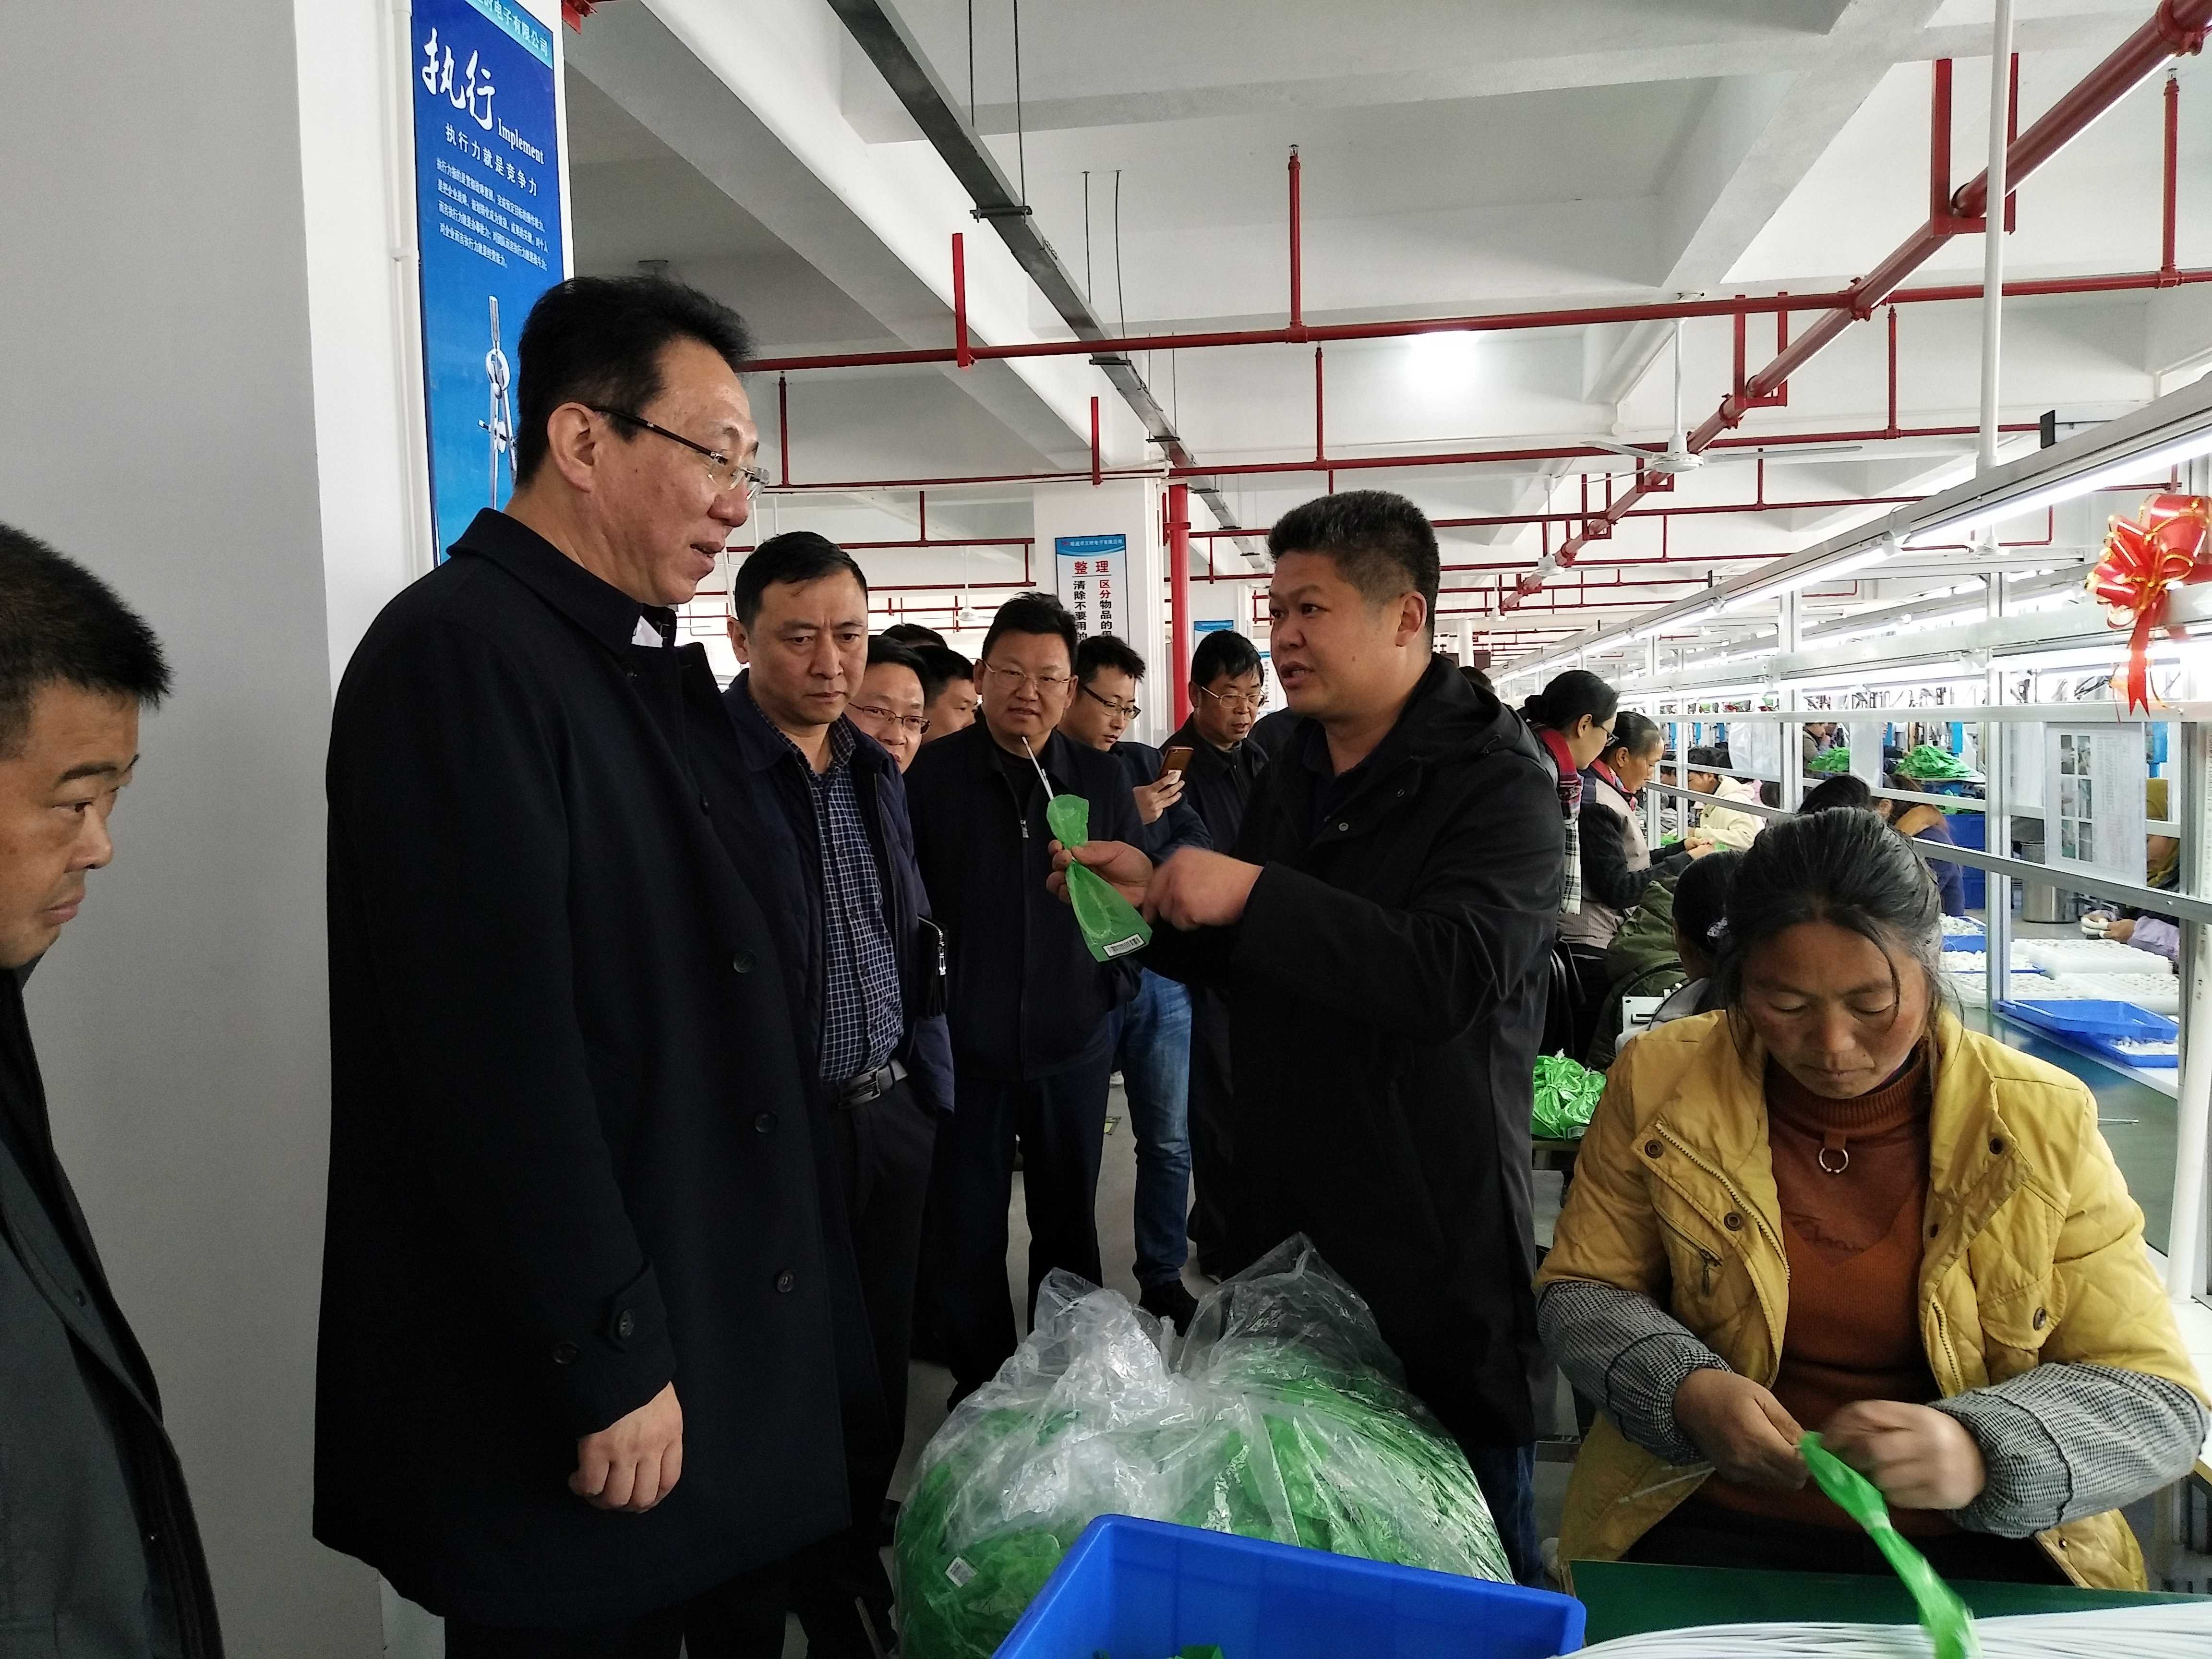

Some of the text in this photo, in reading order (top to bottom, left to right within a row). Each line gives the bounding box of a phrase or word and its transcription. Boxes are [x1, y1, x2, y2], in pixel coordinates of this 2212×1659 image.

[422, 27, 495, 131] 执行
[445, 122, 537, 197] 执行力就是竞争力
[497, 117, 545, 165] Implement
[1074, 561, 1111, 575] 整理
